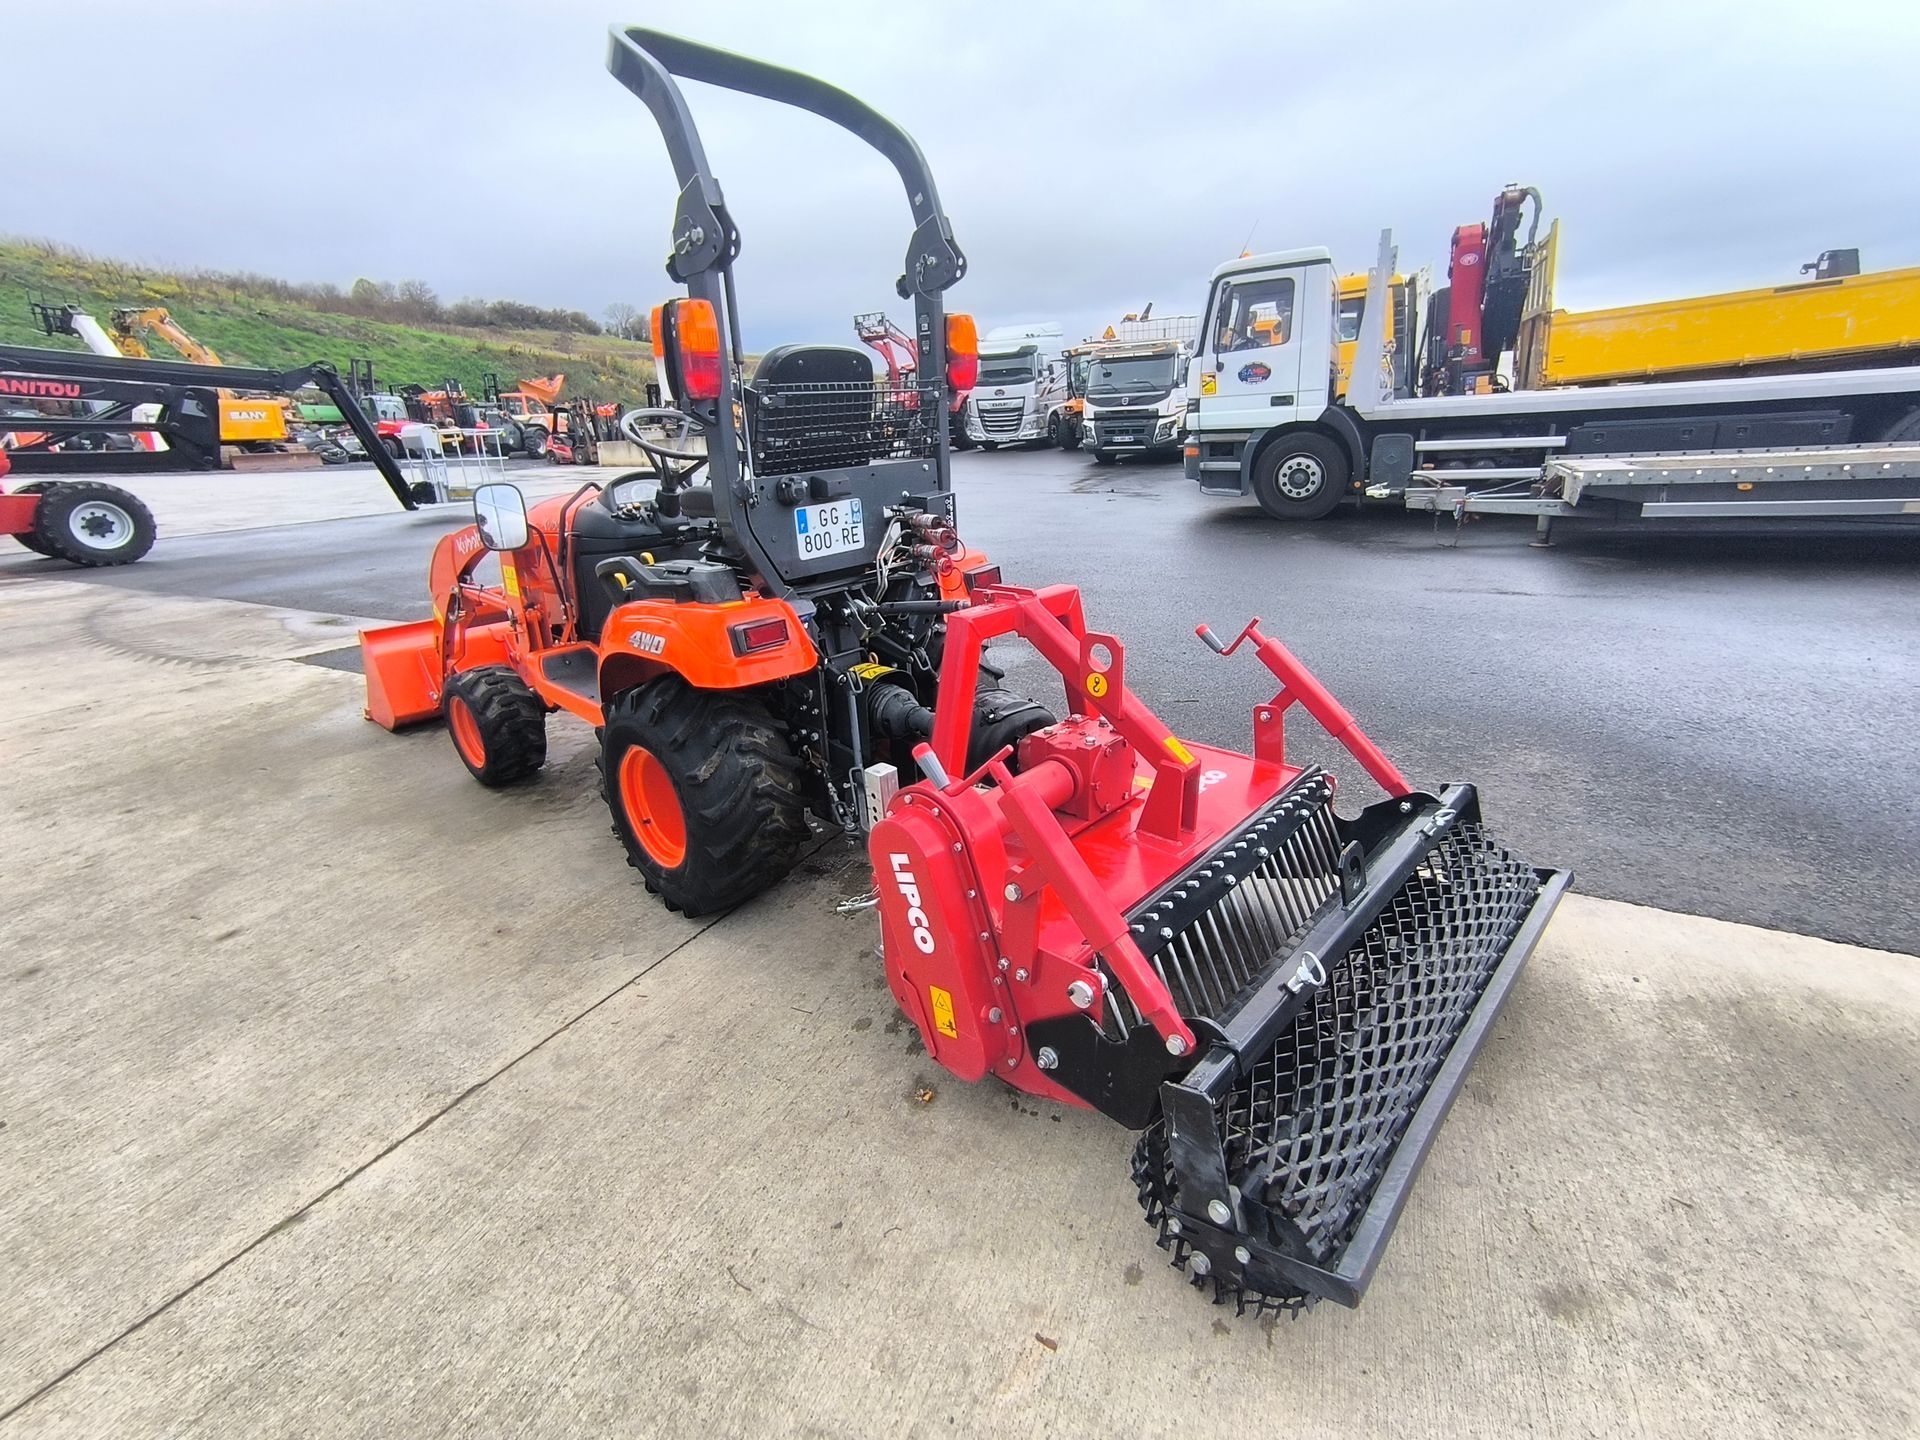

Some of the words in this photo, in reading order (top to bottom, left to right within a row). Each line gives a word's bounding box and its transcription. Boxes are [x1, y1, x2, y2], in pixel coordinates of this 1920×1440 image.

[0, 379, 80, 397] ANITOU
[229, 411, 267, 420] SANY
[629, 630, 666, 655] 4WD
[888, 853, 935, 954] LIPCO
